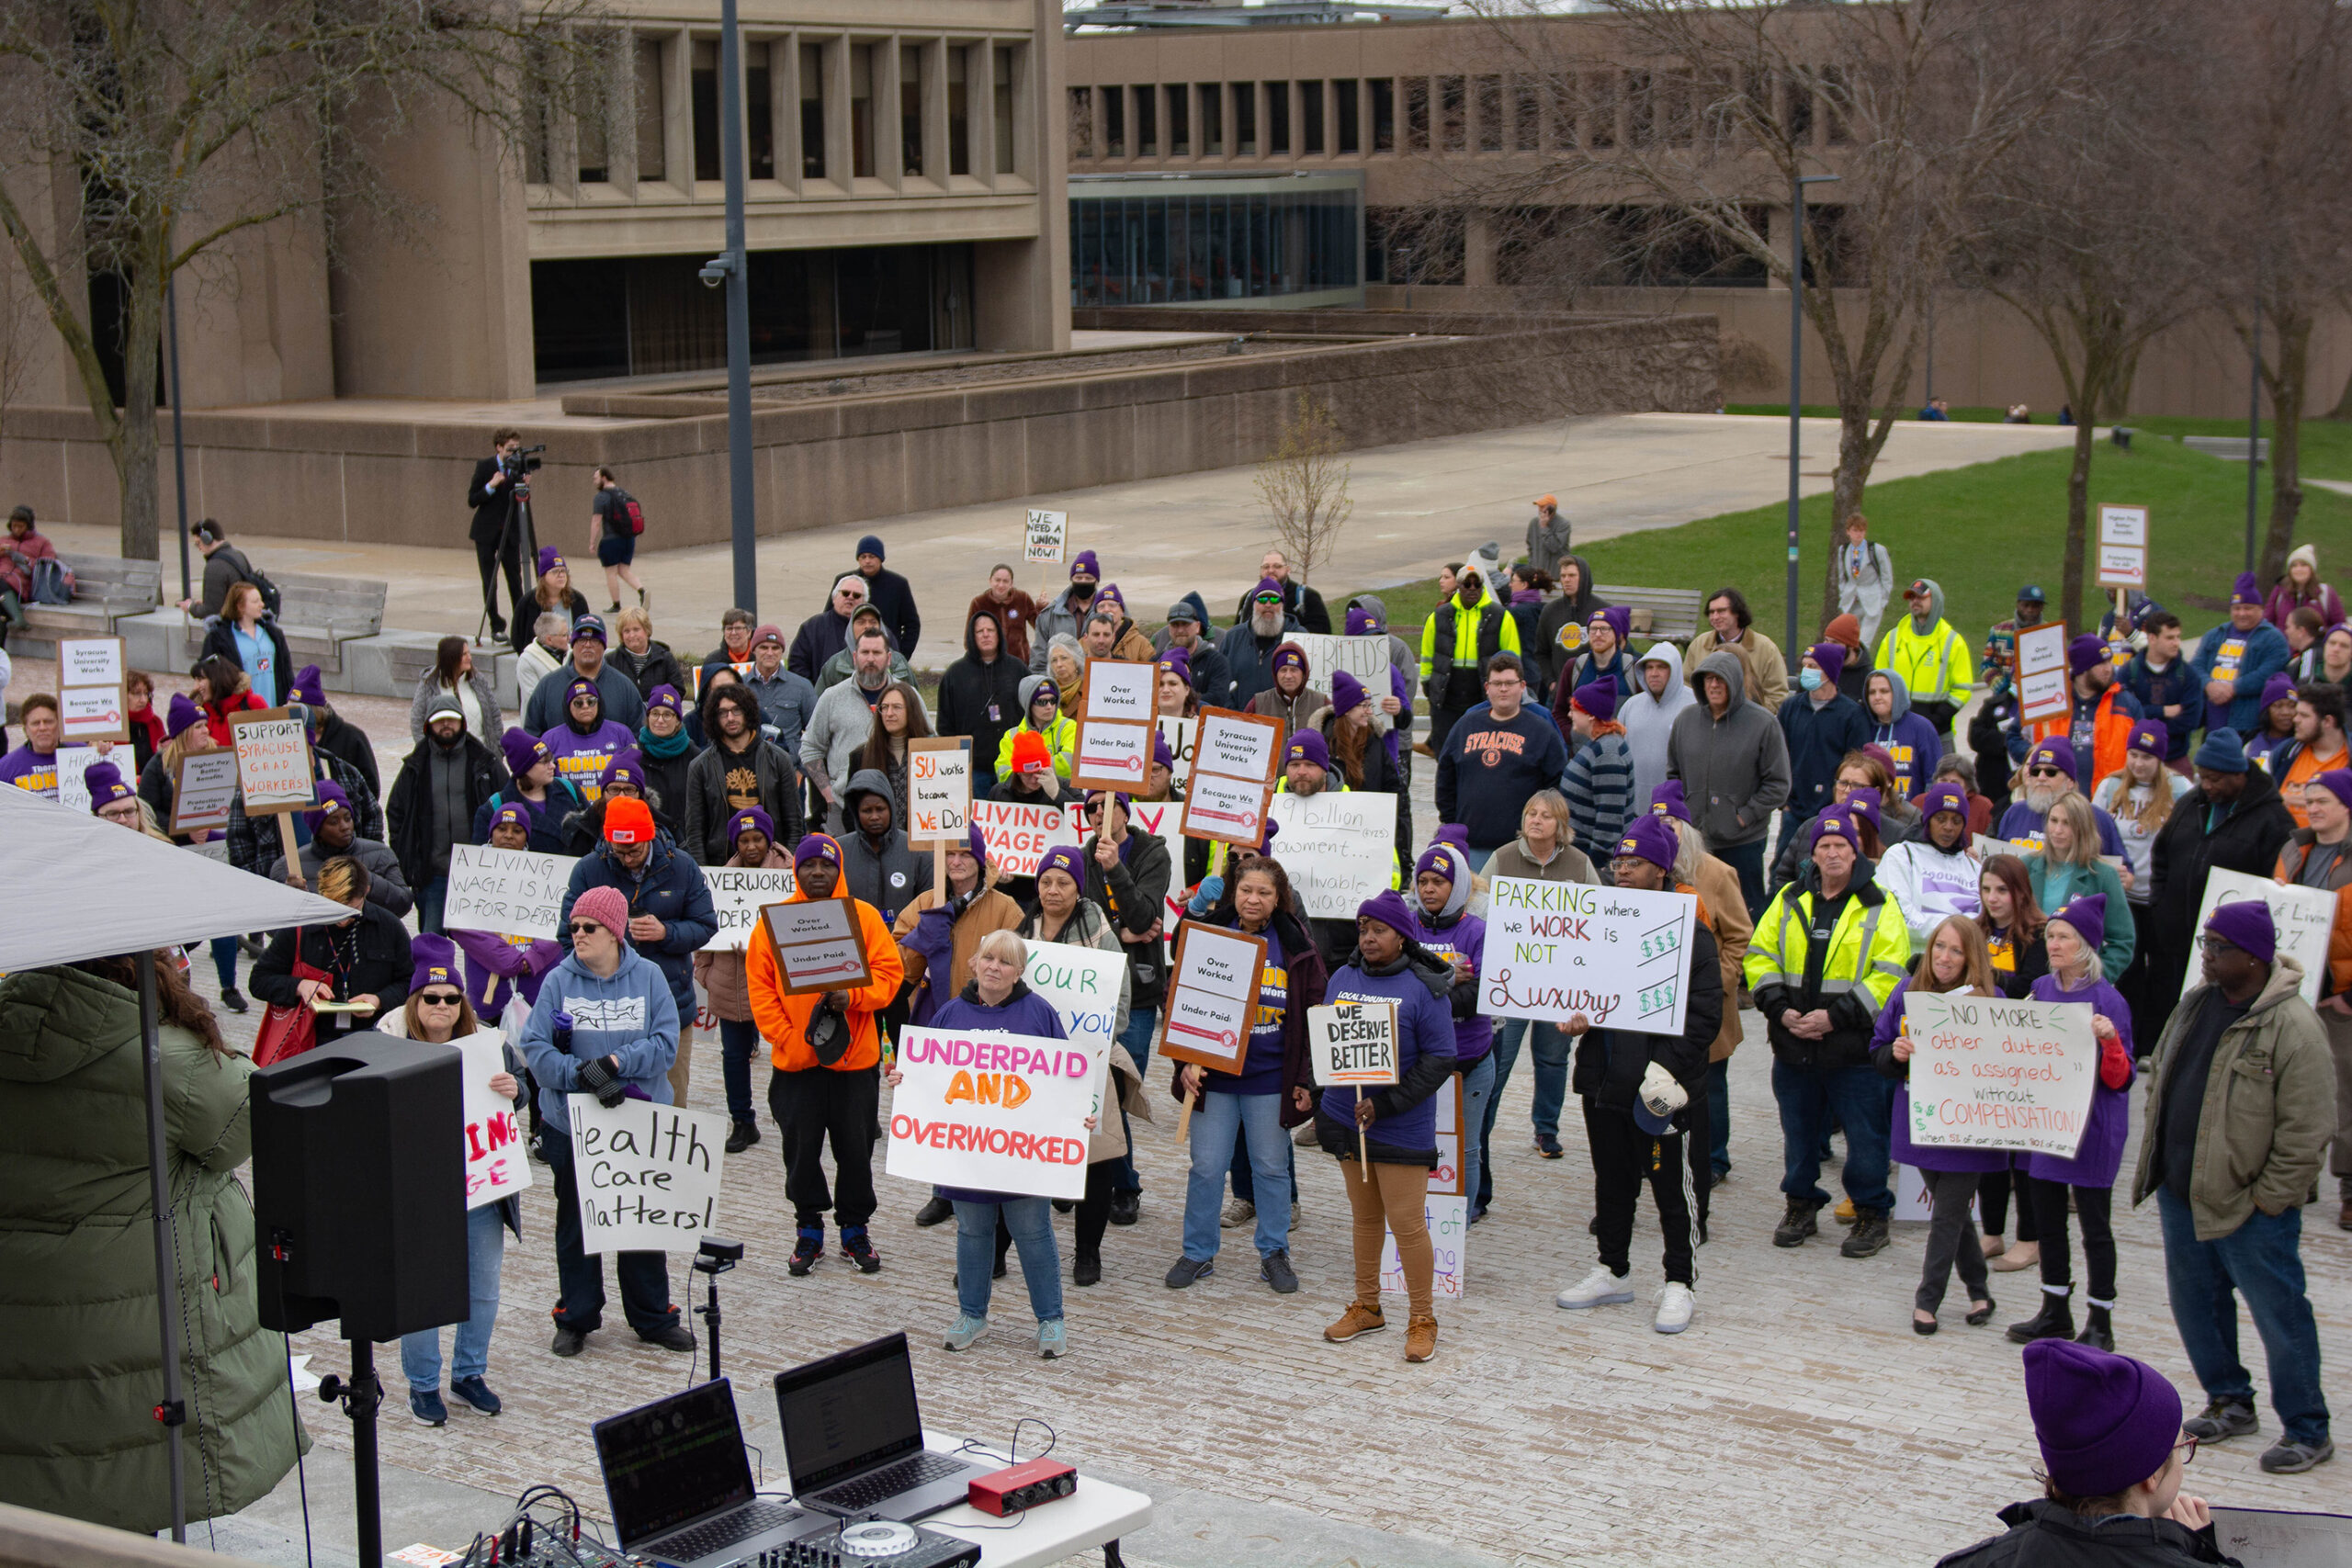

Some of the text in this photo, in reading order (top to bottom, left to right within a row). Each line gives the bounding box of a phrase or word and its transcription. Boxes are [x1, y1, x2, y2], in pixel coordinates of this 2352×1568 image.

[1028, 512, 1052, 524] WE
[1027, 524, 1062, 534] NEED A
[1031, 535, 1060, 545] UNION
[1028, 547, 1056, 558] NOW!
[74, 658, 109, 666] University
[75, 649, 107, 657] Syracuse
[1111, 685, 1131, 694] Over
[1103, 696, 1137, 705] Worked.
[237, 722, 301, 740] SUPPORT
[1219, 728, 1258, 743] Syracuse
[238, 741, 300, 759] SYRACUSE
[1090, 738, 1114, 749] Under
[1215, 739, 1258, 755] University
[1464, 730, 1526, 755] SYRACUSE
[191, 761, 215, 769] Higher
[250, 761, 288, 773] GRAD
[914, 756, 965, 778] SU works
[1221, 752, 1249, 763] Works
[196, 773, 223, 782] Benefits
[243, 778, 310, 794] WORKERS!
[187, 796, 225, 807] Protections
[1202, 787, 1254, 803] Because We
[916, 806, 967, 831] WE Do!
[972, 801, 1060, 830] LIVING
[1305, 800, 1363, 826] billion
[979, 825, 1046, 854] WAGE
[457, 848, 554, 880] A LIVING
[986, 851, 1039, 874] NOW
[451, 874, 570, 903] WAGE IS NO
[1311, 866, 1369, 894] livable
[1495, 881, 1641, 918] PARKING where
[448, 897, 558, 927] UP FOR DEBA
[791, 924, 831, 933] Worked.
[1504, 915, 1618, 942] we WORK is
[793, 955, 821, 964] Under
[1206, 956, 1229, 969] Over
[1515, 942, 1586, 966] NOT a
[1197, 966, 1234, 983] Worked.
[1337, 990, 1361, 1001] LOCAL
[1488, 968, 1621, 1024] Luxury
[1181, 1003, 1207, 1017] Under
[1336, 1005, 1362, 1020] WE
[1951, 1005, 2042, 1029] NO MORE
[1328, 1020, 1389, 1043] DESERVE
[2002, 1034, 2064, 1055] duties
[906, 1036, 1088, 1077] UNDERPAID
[1331, 1042, 1391, 1070] BETTER
[1934, 1061, 2062, 1087] as assigned
[944, 1069, 1031, 1110] AND
[1939, 1099, 2081, 1137] COMPENSATION!
[466, 1110, 518, 1162] ING
[572, 1105, 710, 1173] Health
[890, 1114, 1085, 1166] OVERWORKED
[592, 1160, 672, 1191] Care
[1440, 1209, 1461, 1235] of
